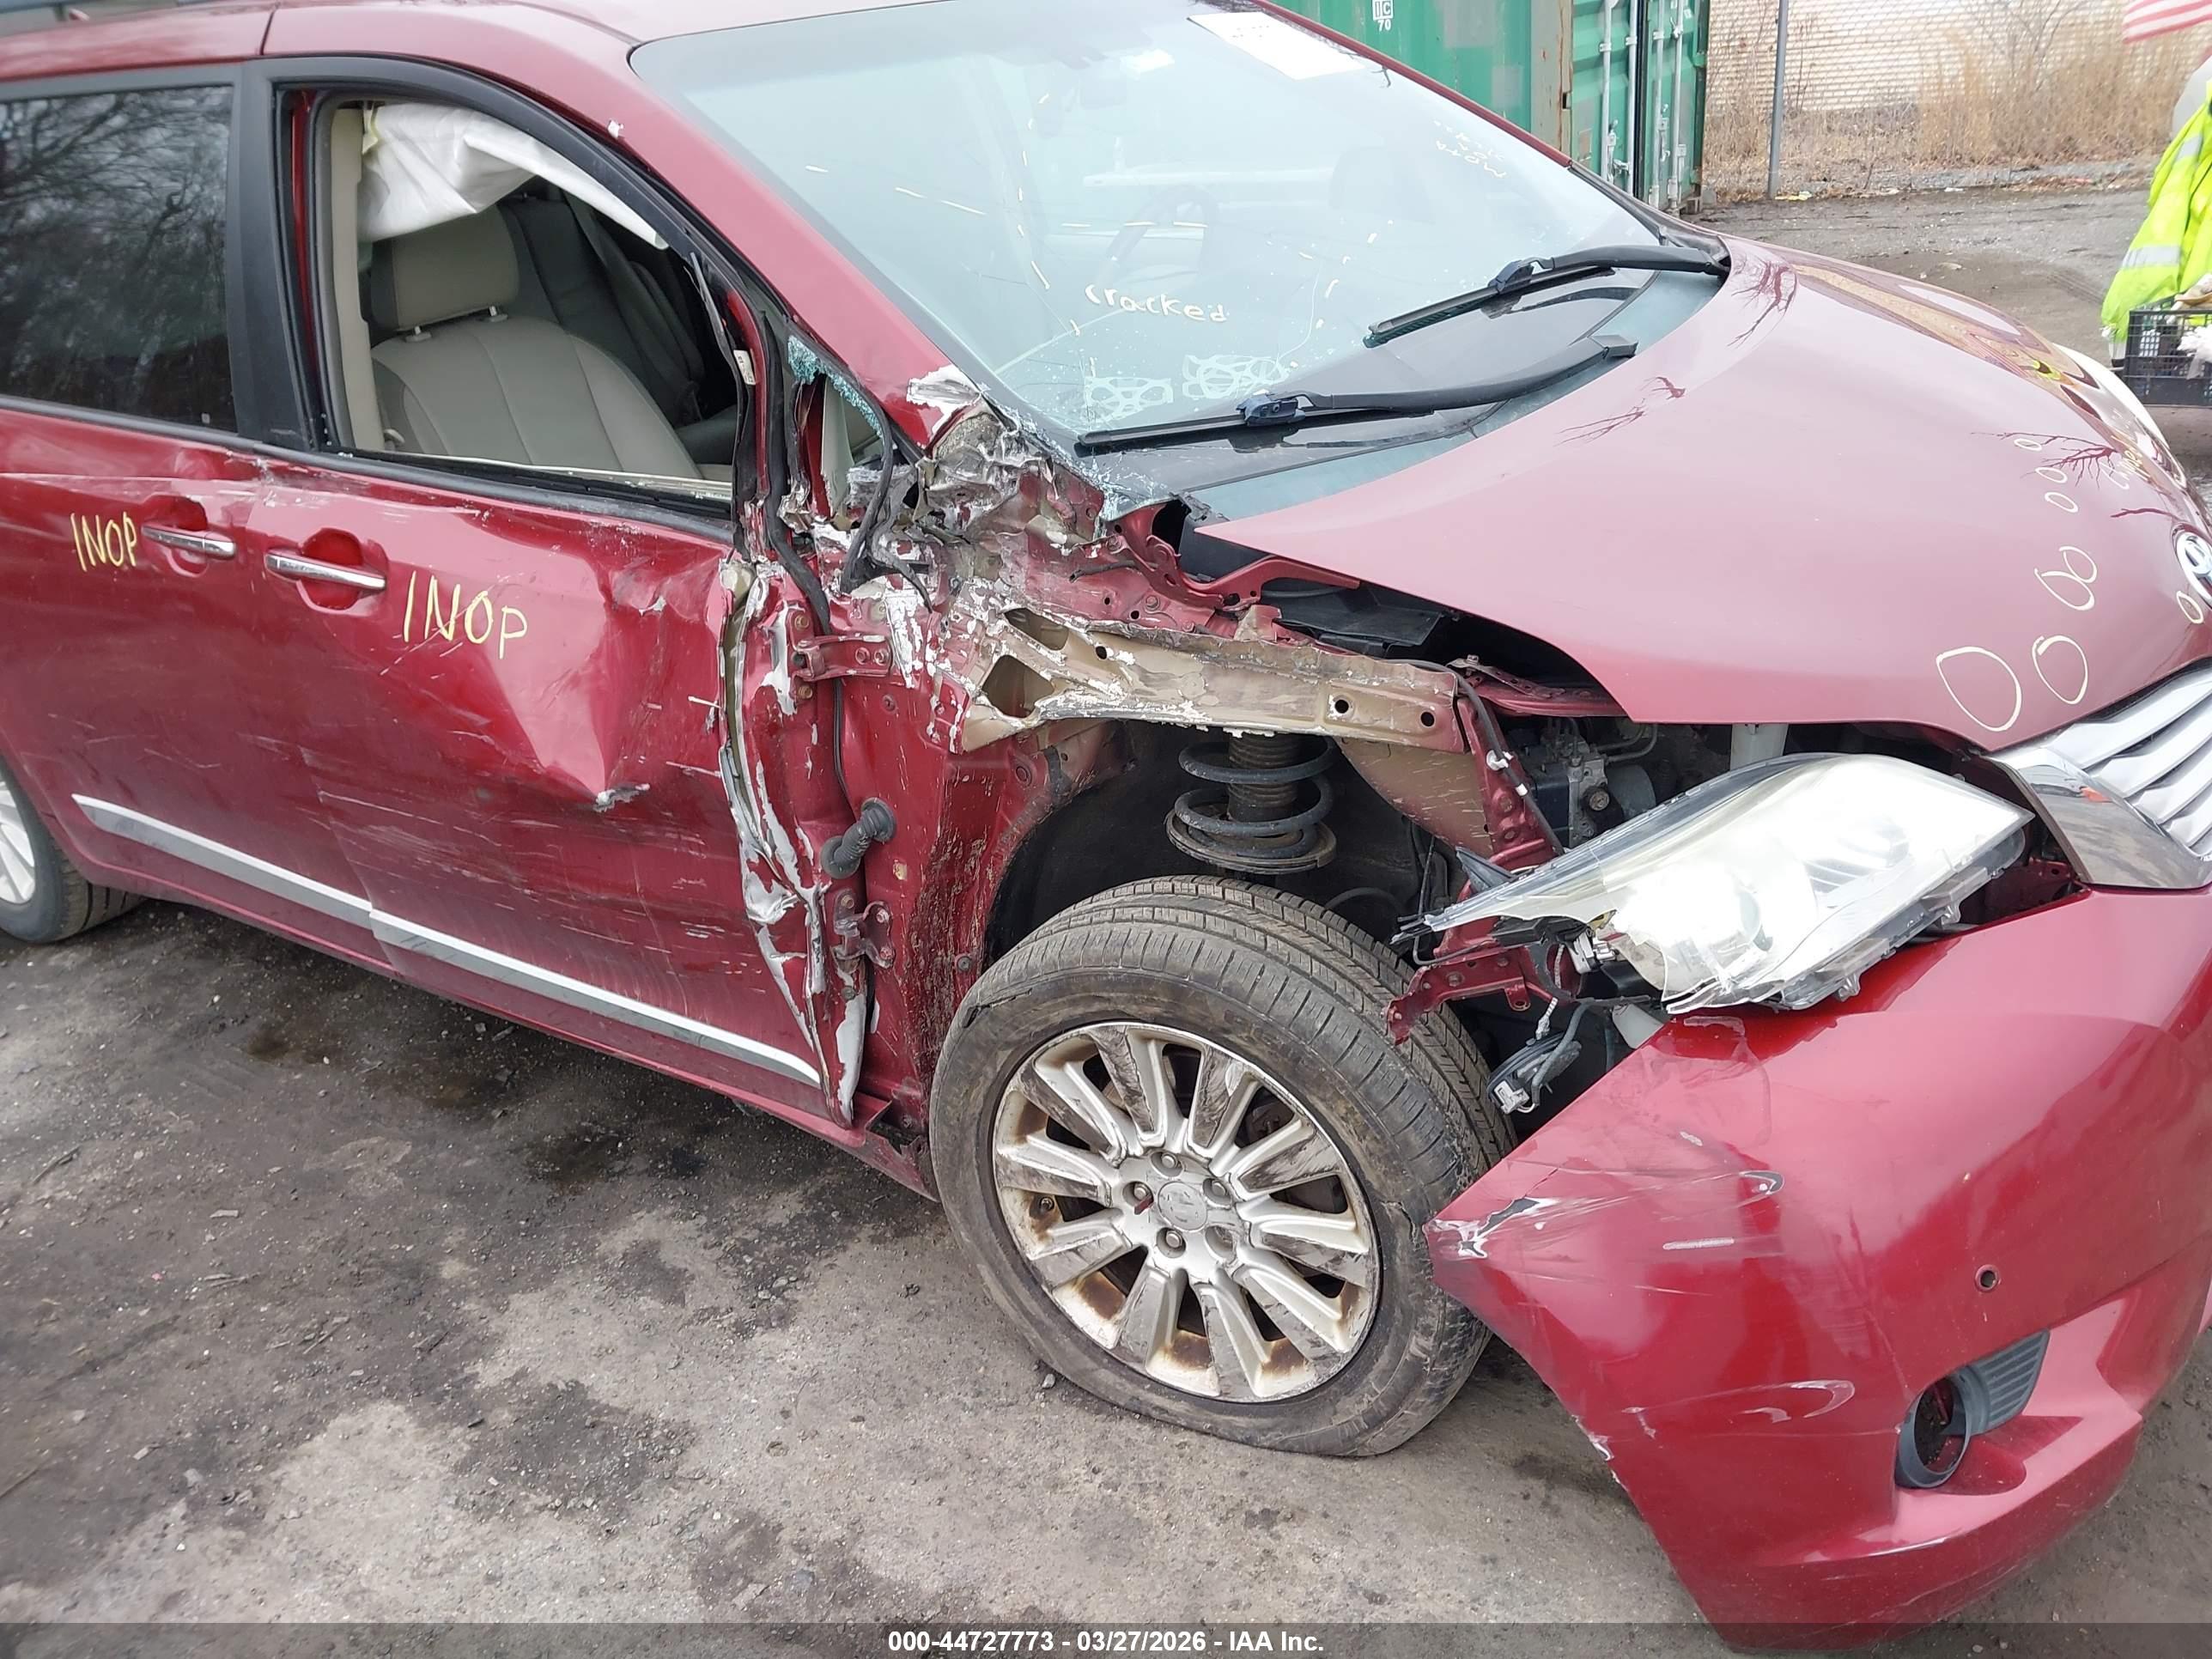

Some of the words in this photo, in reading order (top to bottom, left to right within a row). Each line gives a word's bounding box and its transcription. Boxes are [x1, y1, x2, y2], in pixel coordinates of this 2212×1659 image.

[1377, 19, 1392, 32] 70
[70, 511, 137, 573] INOP
[403, 570, 528, 660] INOP
